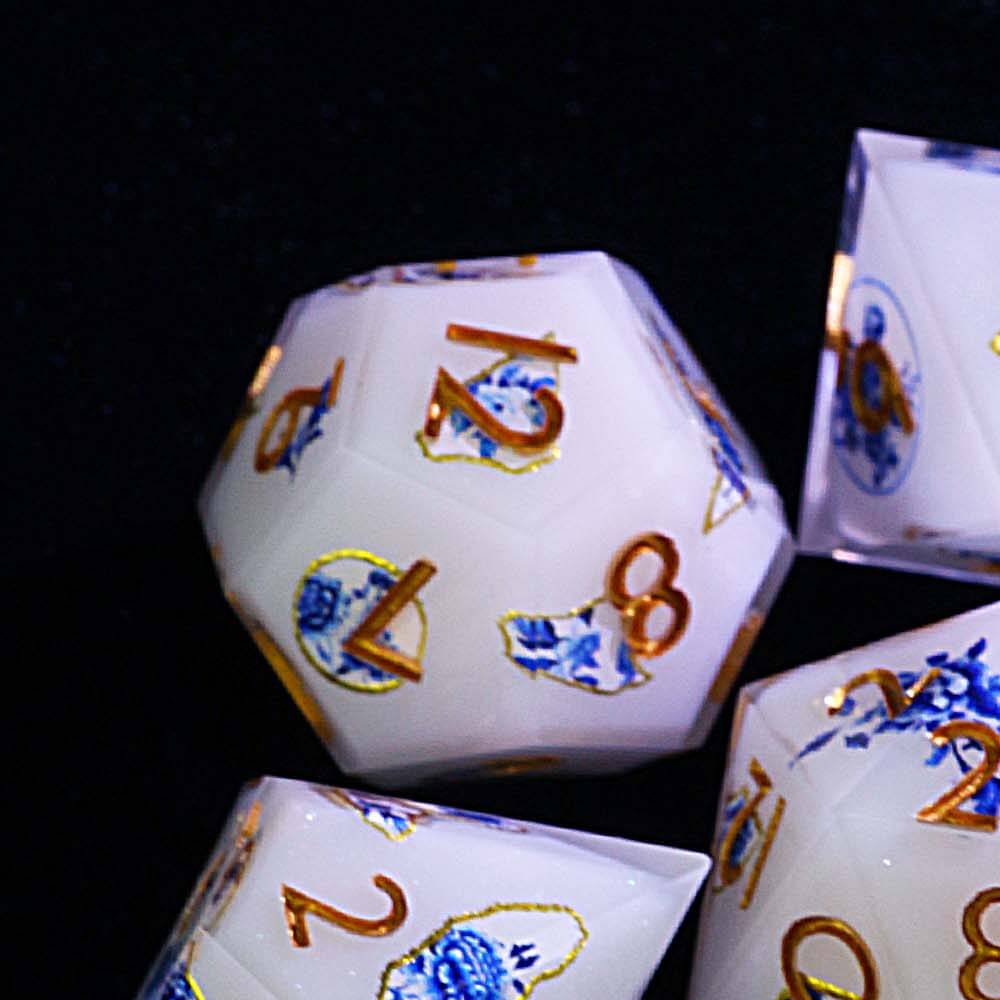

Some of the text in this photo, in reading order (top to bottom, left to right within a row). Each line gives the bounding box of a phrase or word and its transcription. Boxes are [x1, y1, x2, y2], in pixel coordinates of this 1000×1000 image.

[424, 322, 578, 454] 12
[342, 559, 438, 682] 7
[606, 531, 692, 659] 8
[281, 873, 408, 948] 2
